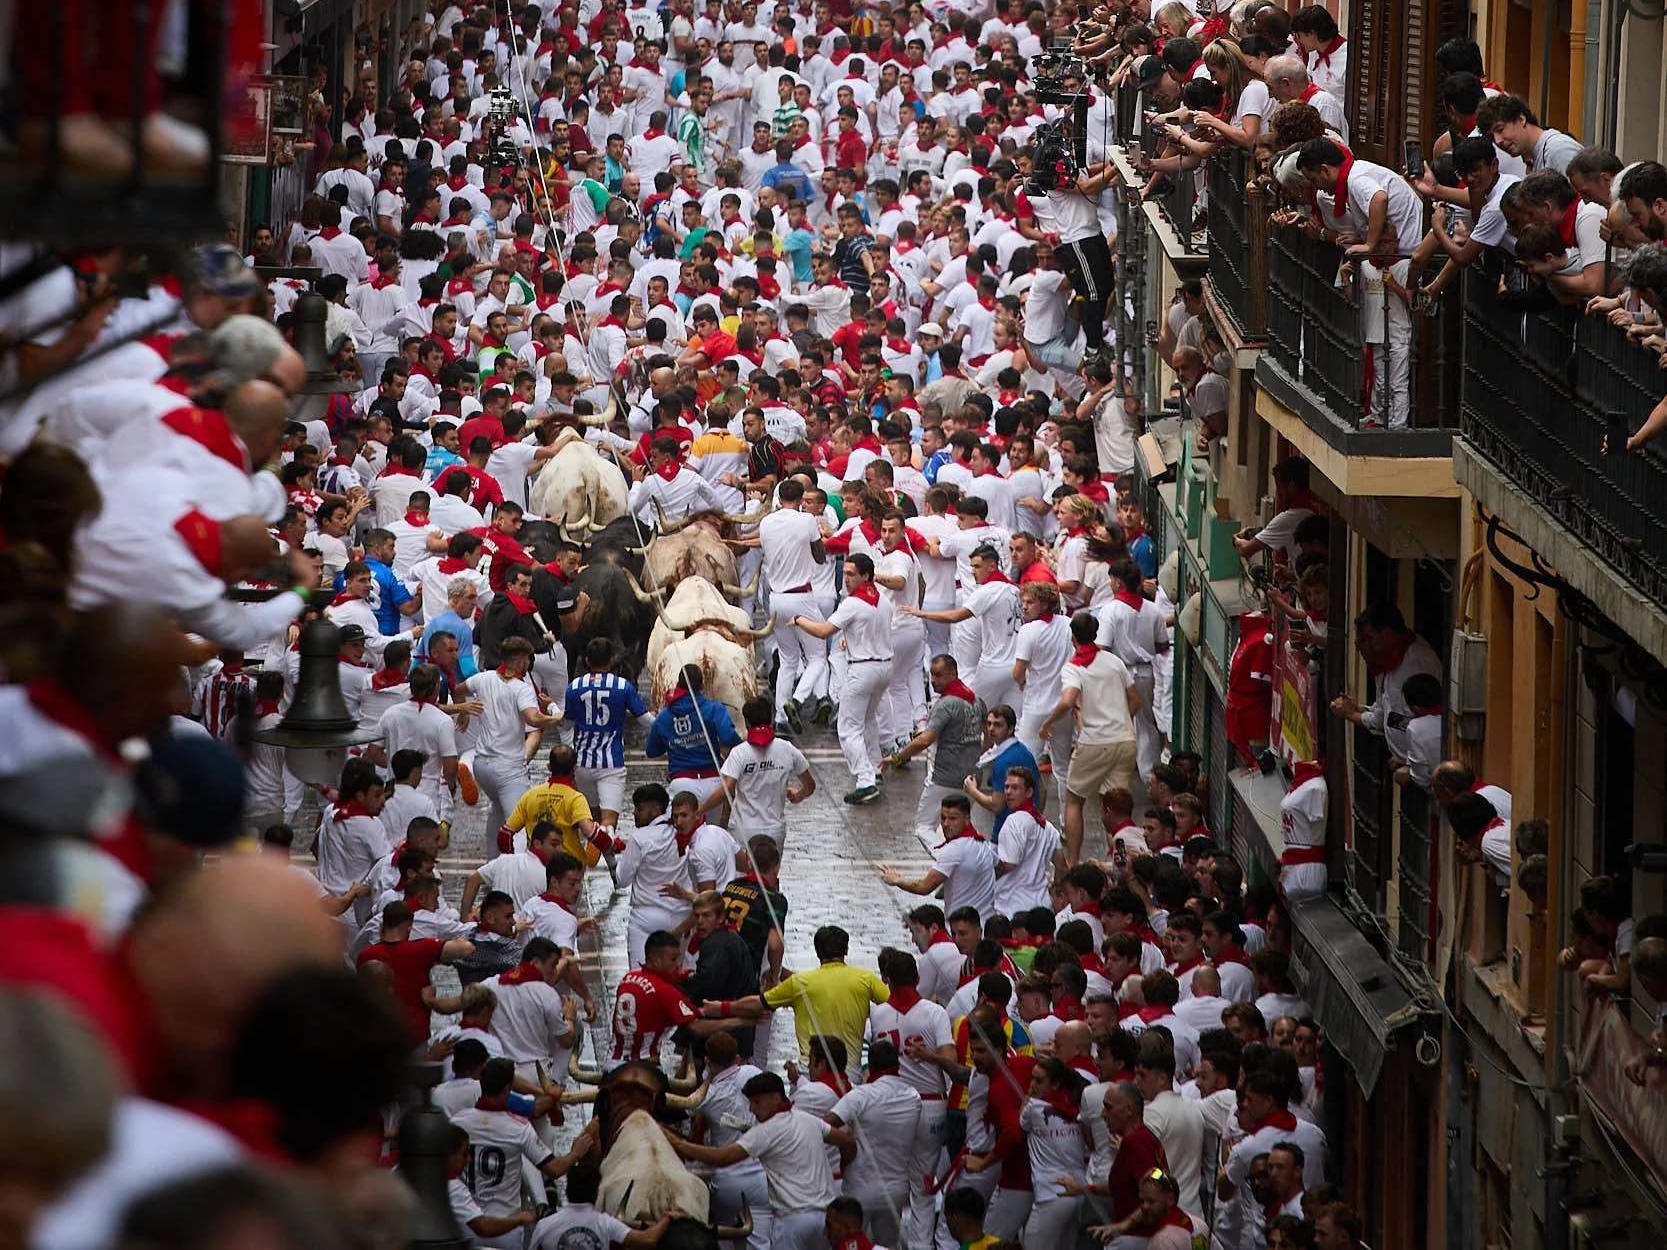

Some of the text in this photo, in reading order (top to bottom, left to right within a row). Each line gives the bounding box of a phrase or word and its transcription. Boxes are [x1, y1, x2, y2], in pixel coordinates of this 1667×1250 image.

[580, 690, 611, 727] 15
[624, 974, 656, 995] SANCET
[616, 992, 638, 1036] 8
